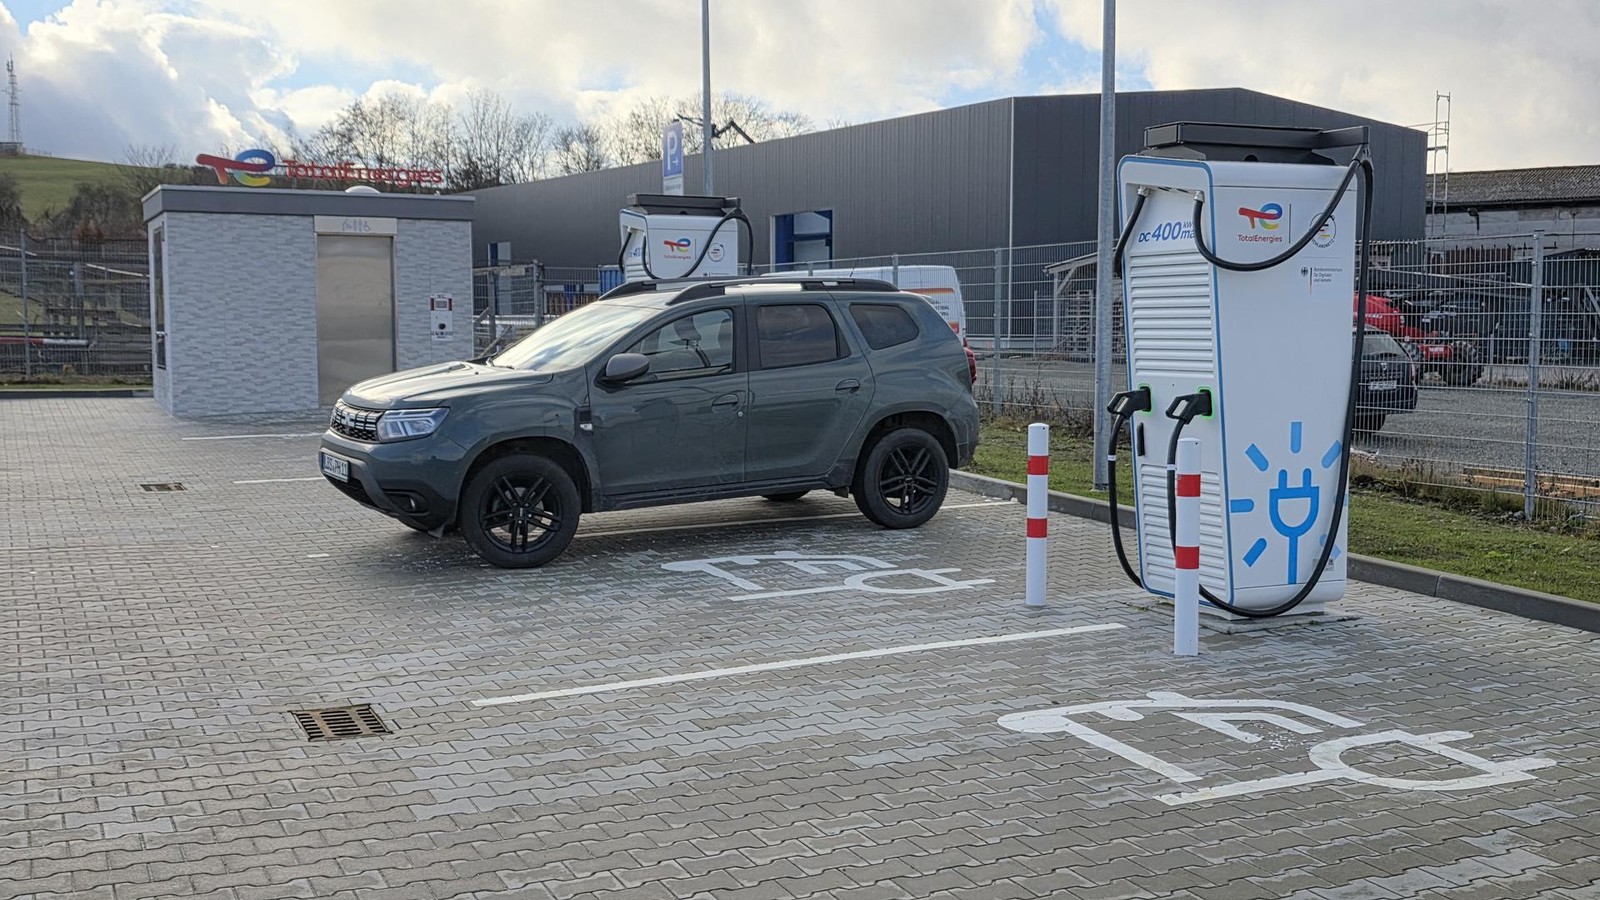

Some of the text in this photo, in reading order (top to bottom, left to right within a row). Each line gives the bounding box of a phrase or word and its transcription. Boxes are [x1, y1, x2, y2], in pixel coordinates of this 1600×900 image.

[667, 131, 677, 170] P
[283, 160, 442, 187] TotalEnergies
[1139, 221, 1194, 242] DC 400 ma
[1238, 234, 1282, 244] TotalEnergies
